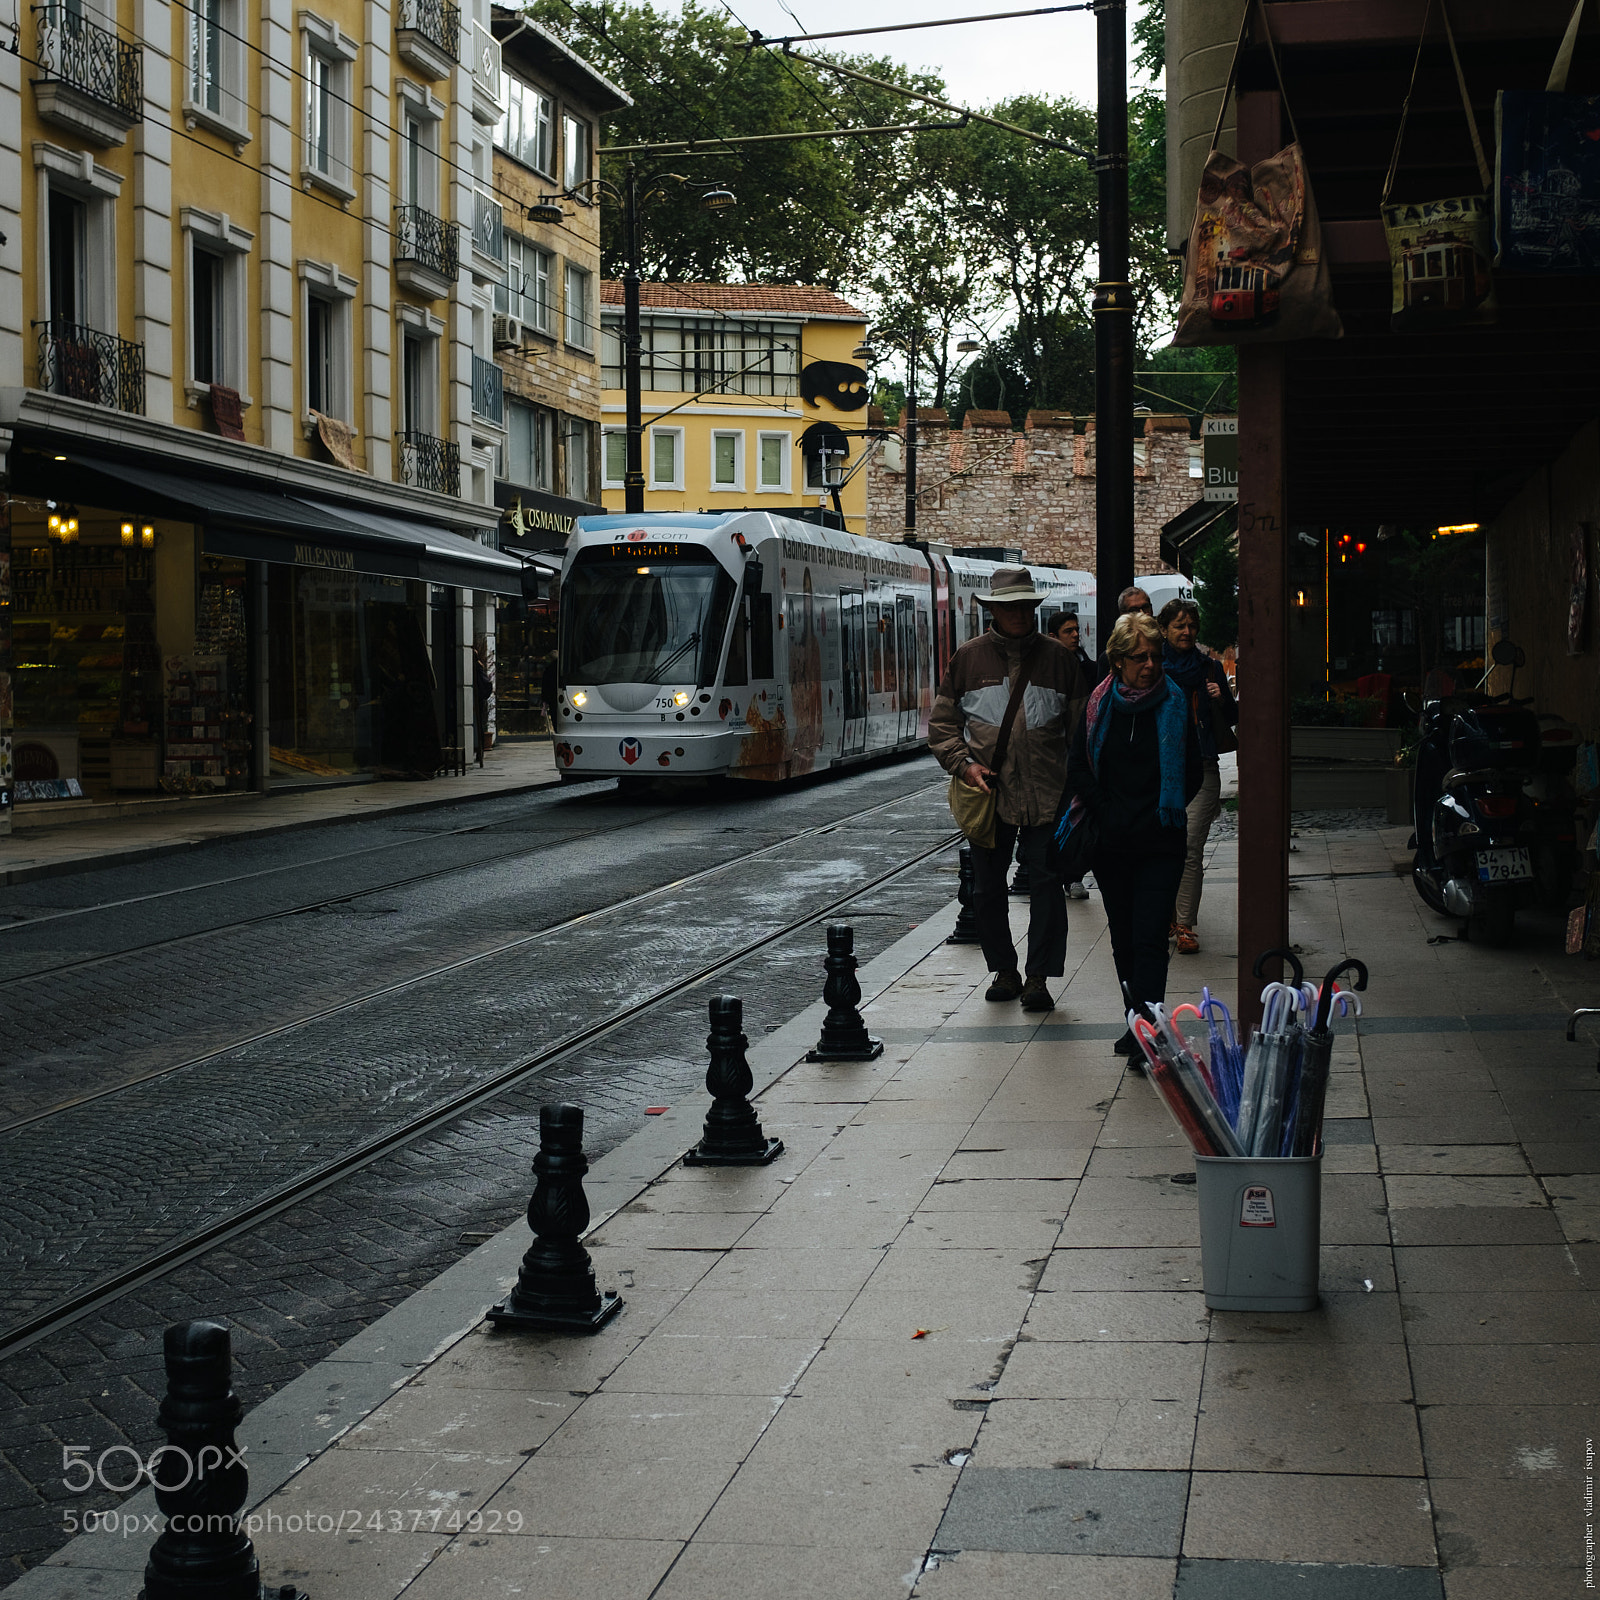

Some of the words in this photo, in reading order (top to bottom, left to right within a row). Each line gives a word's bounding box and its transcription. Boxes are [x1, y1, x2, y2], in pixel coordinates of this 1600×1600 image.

[1207, 466, 1239, 485] Blu
[528, 508, 576, 535] OSMANLIZ
[294, 543, 355, 569] MILENYUM
[1178, 586, 1195, 599] Ka
[655, 698, 673, 709] 750
[660, 713, 666, 722] B
[1478, 851, 1498, 865] 34
[1490, 863, 1527, 878] 7841
